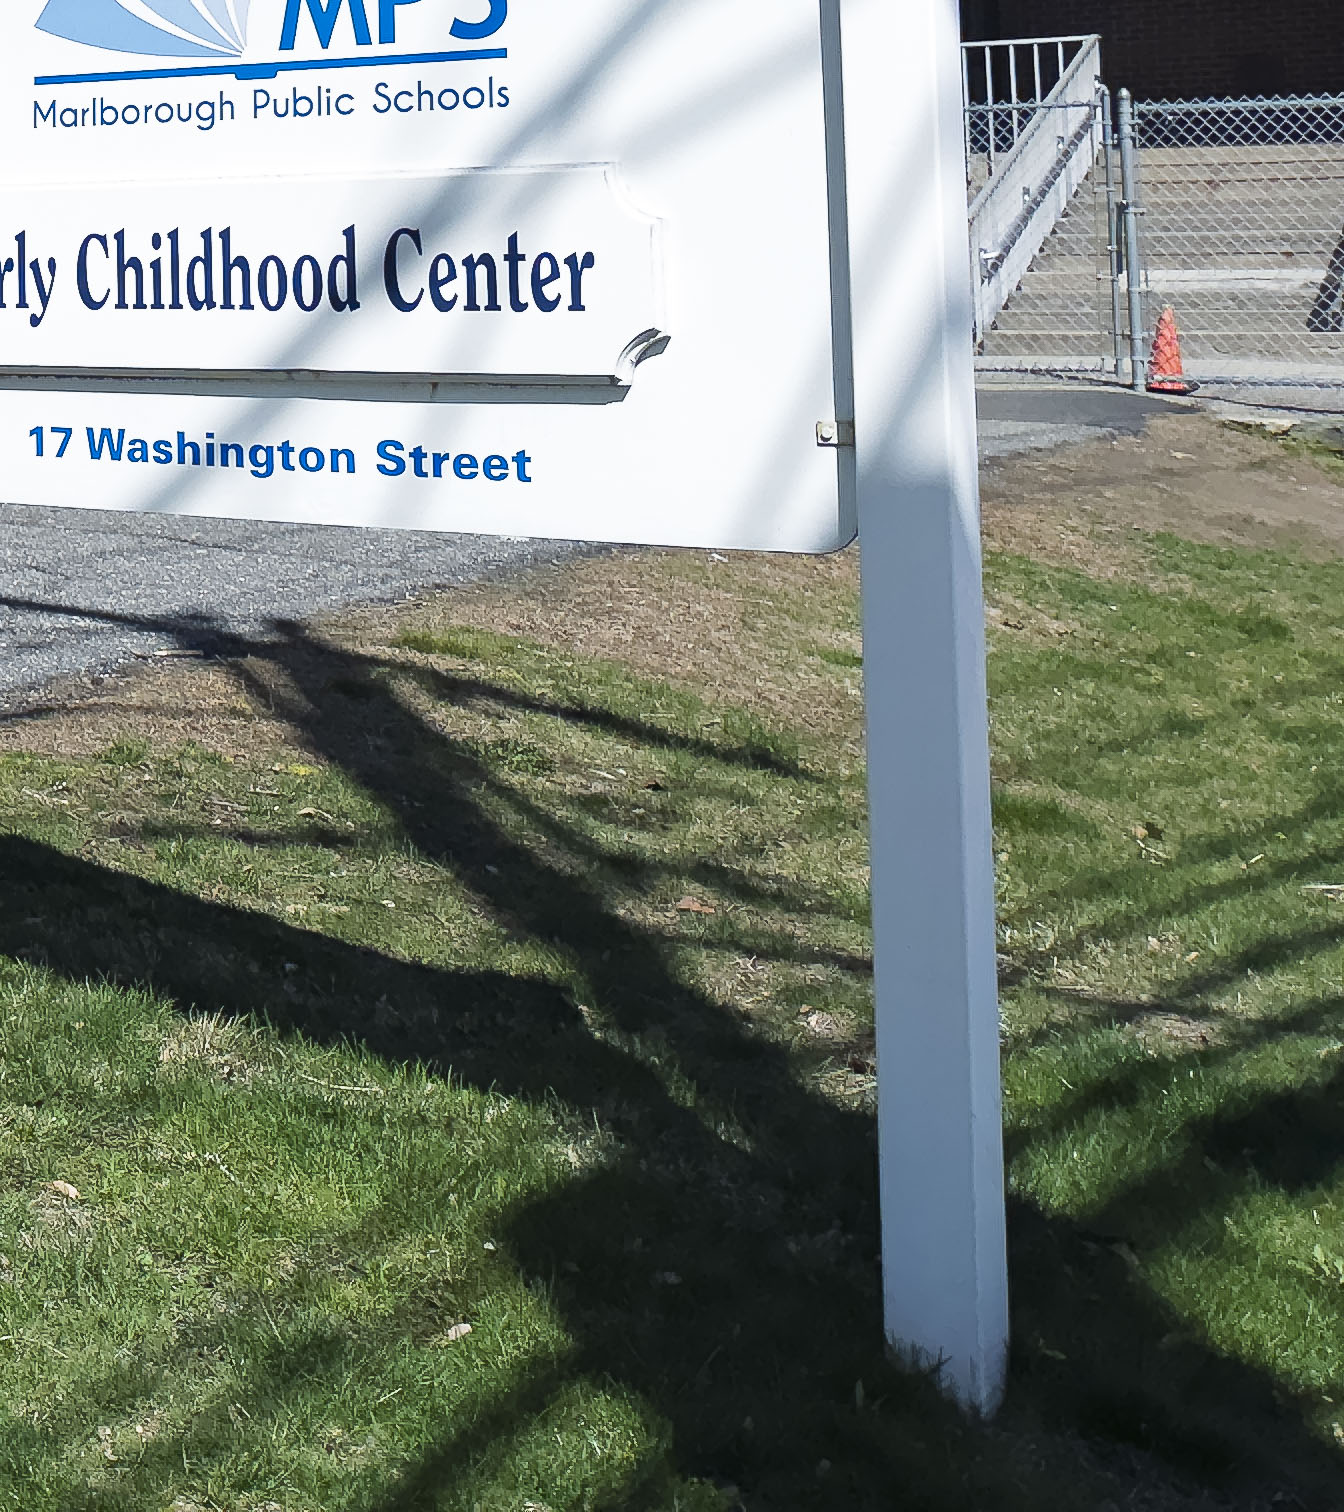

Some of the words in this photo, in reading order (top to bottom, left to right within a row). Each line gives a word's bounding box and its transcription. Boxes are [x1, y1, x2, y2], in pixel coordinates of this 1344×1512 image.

[32, 90, 236, 131] Marlborough
[252, 85, 356, 120] Public
[371, 76, 511, 115] Schools
[75, 223, 362, 314] Childhood
[382, 227, 596, 314] Center
[28, 425, 74, 459] 17
[84, 426, 357, 480] Washington
[375, 439, 533, 484] Street
